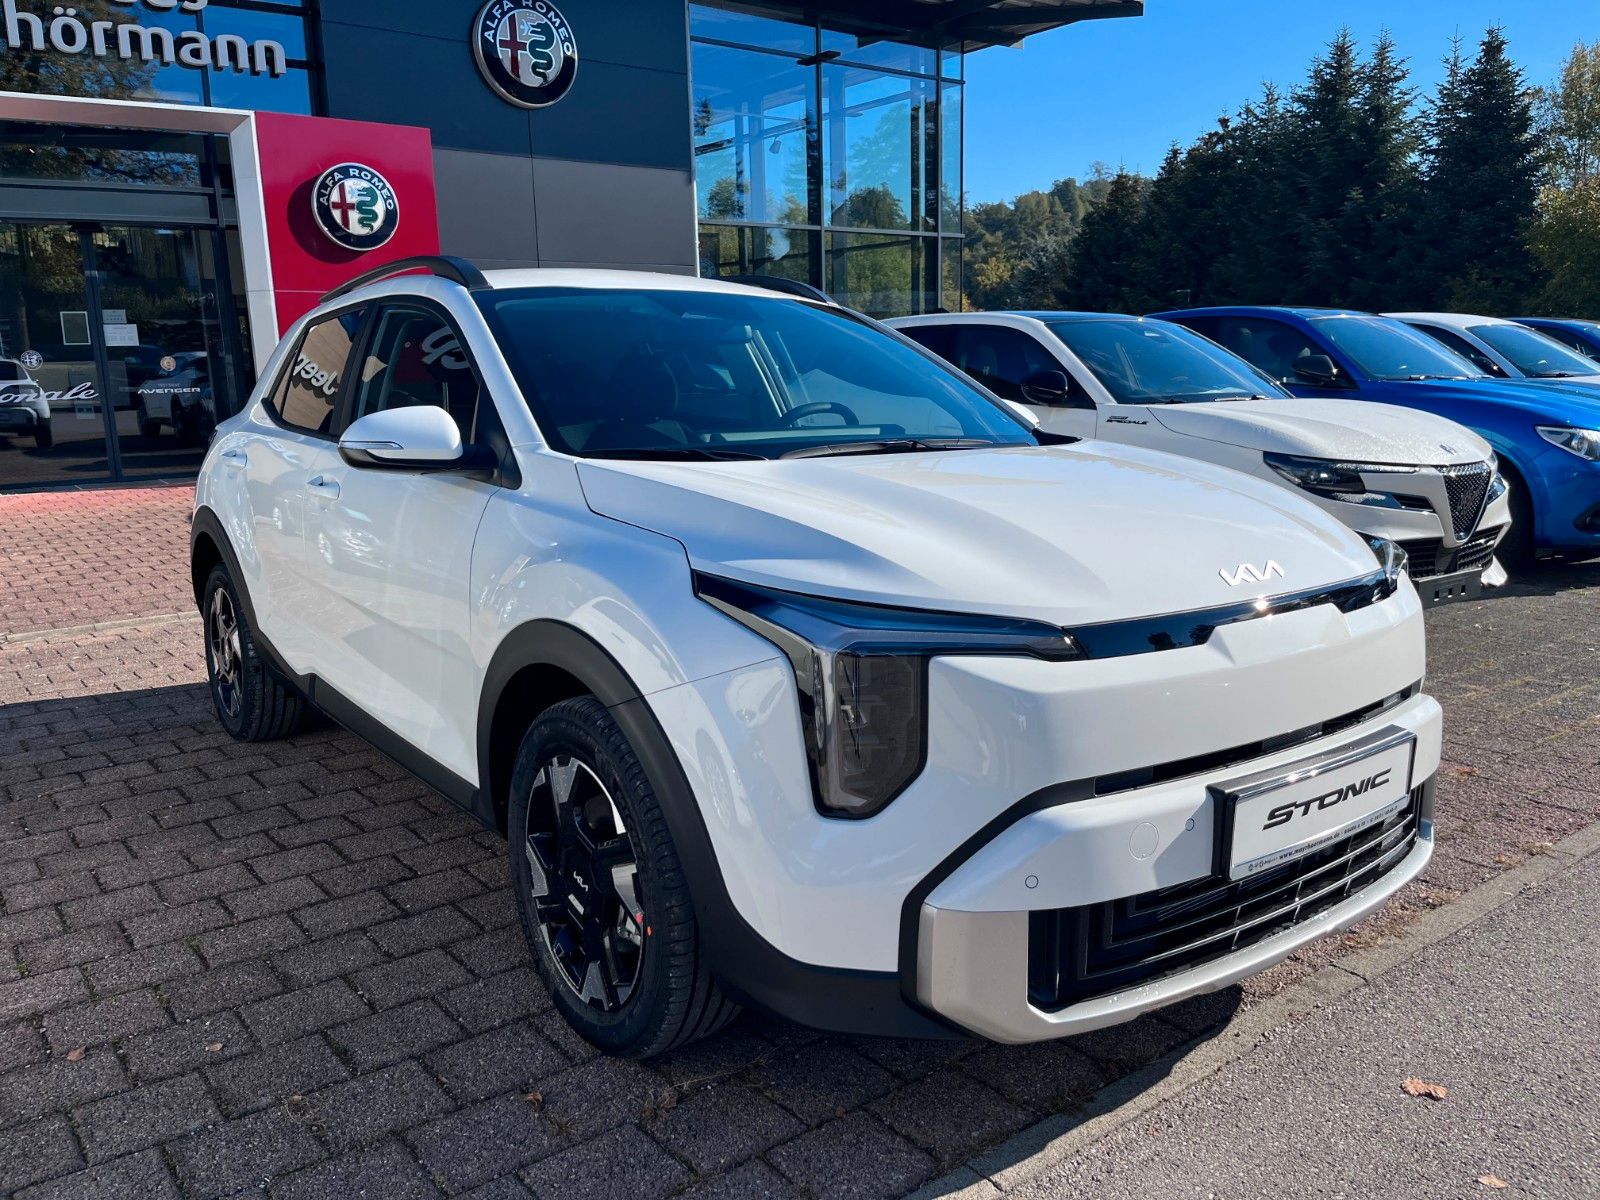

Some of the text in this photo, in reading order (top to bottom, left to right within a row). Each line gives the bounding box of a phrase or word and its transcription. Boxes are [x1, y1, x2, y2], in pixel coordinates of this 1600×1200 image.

[484, 0, 572, 56] ALFA ROMEO
[320, 168, 394, 210] ALFA ROMEO
[138, 387, 201, 395] AVENGER
[1218, 559, 1284, 587] KIA
[1262, 768, 1392, 831] STONIC
